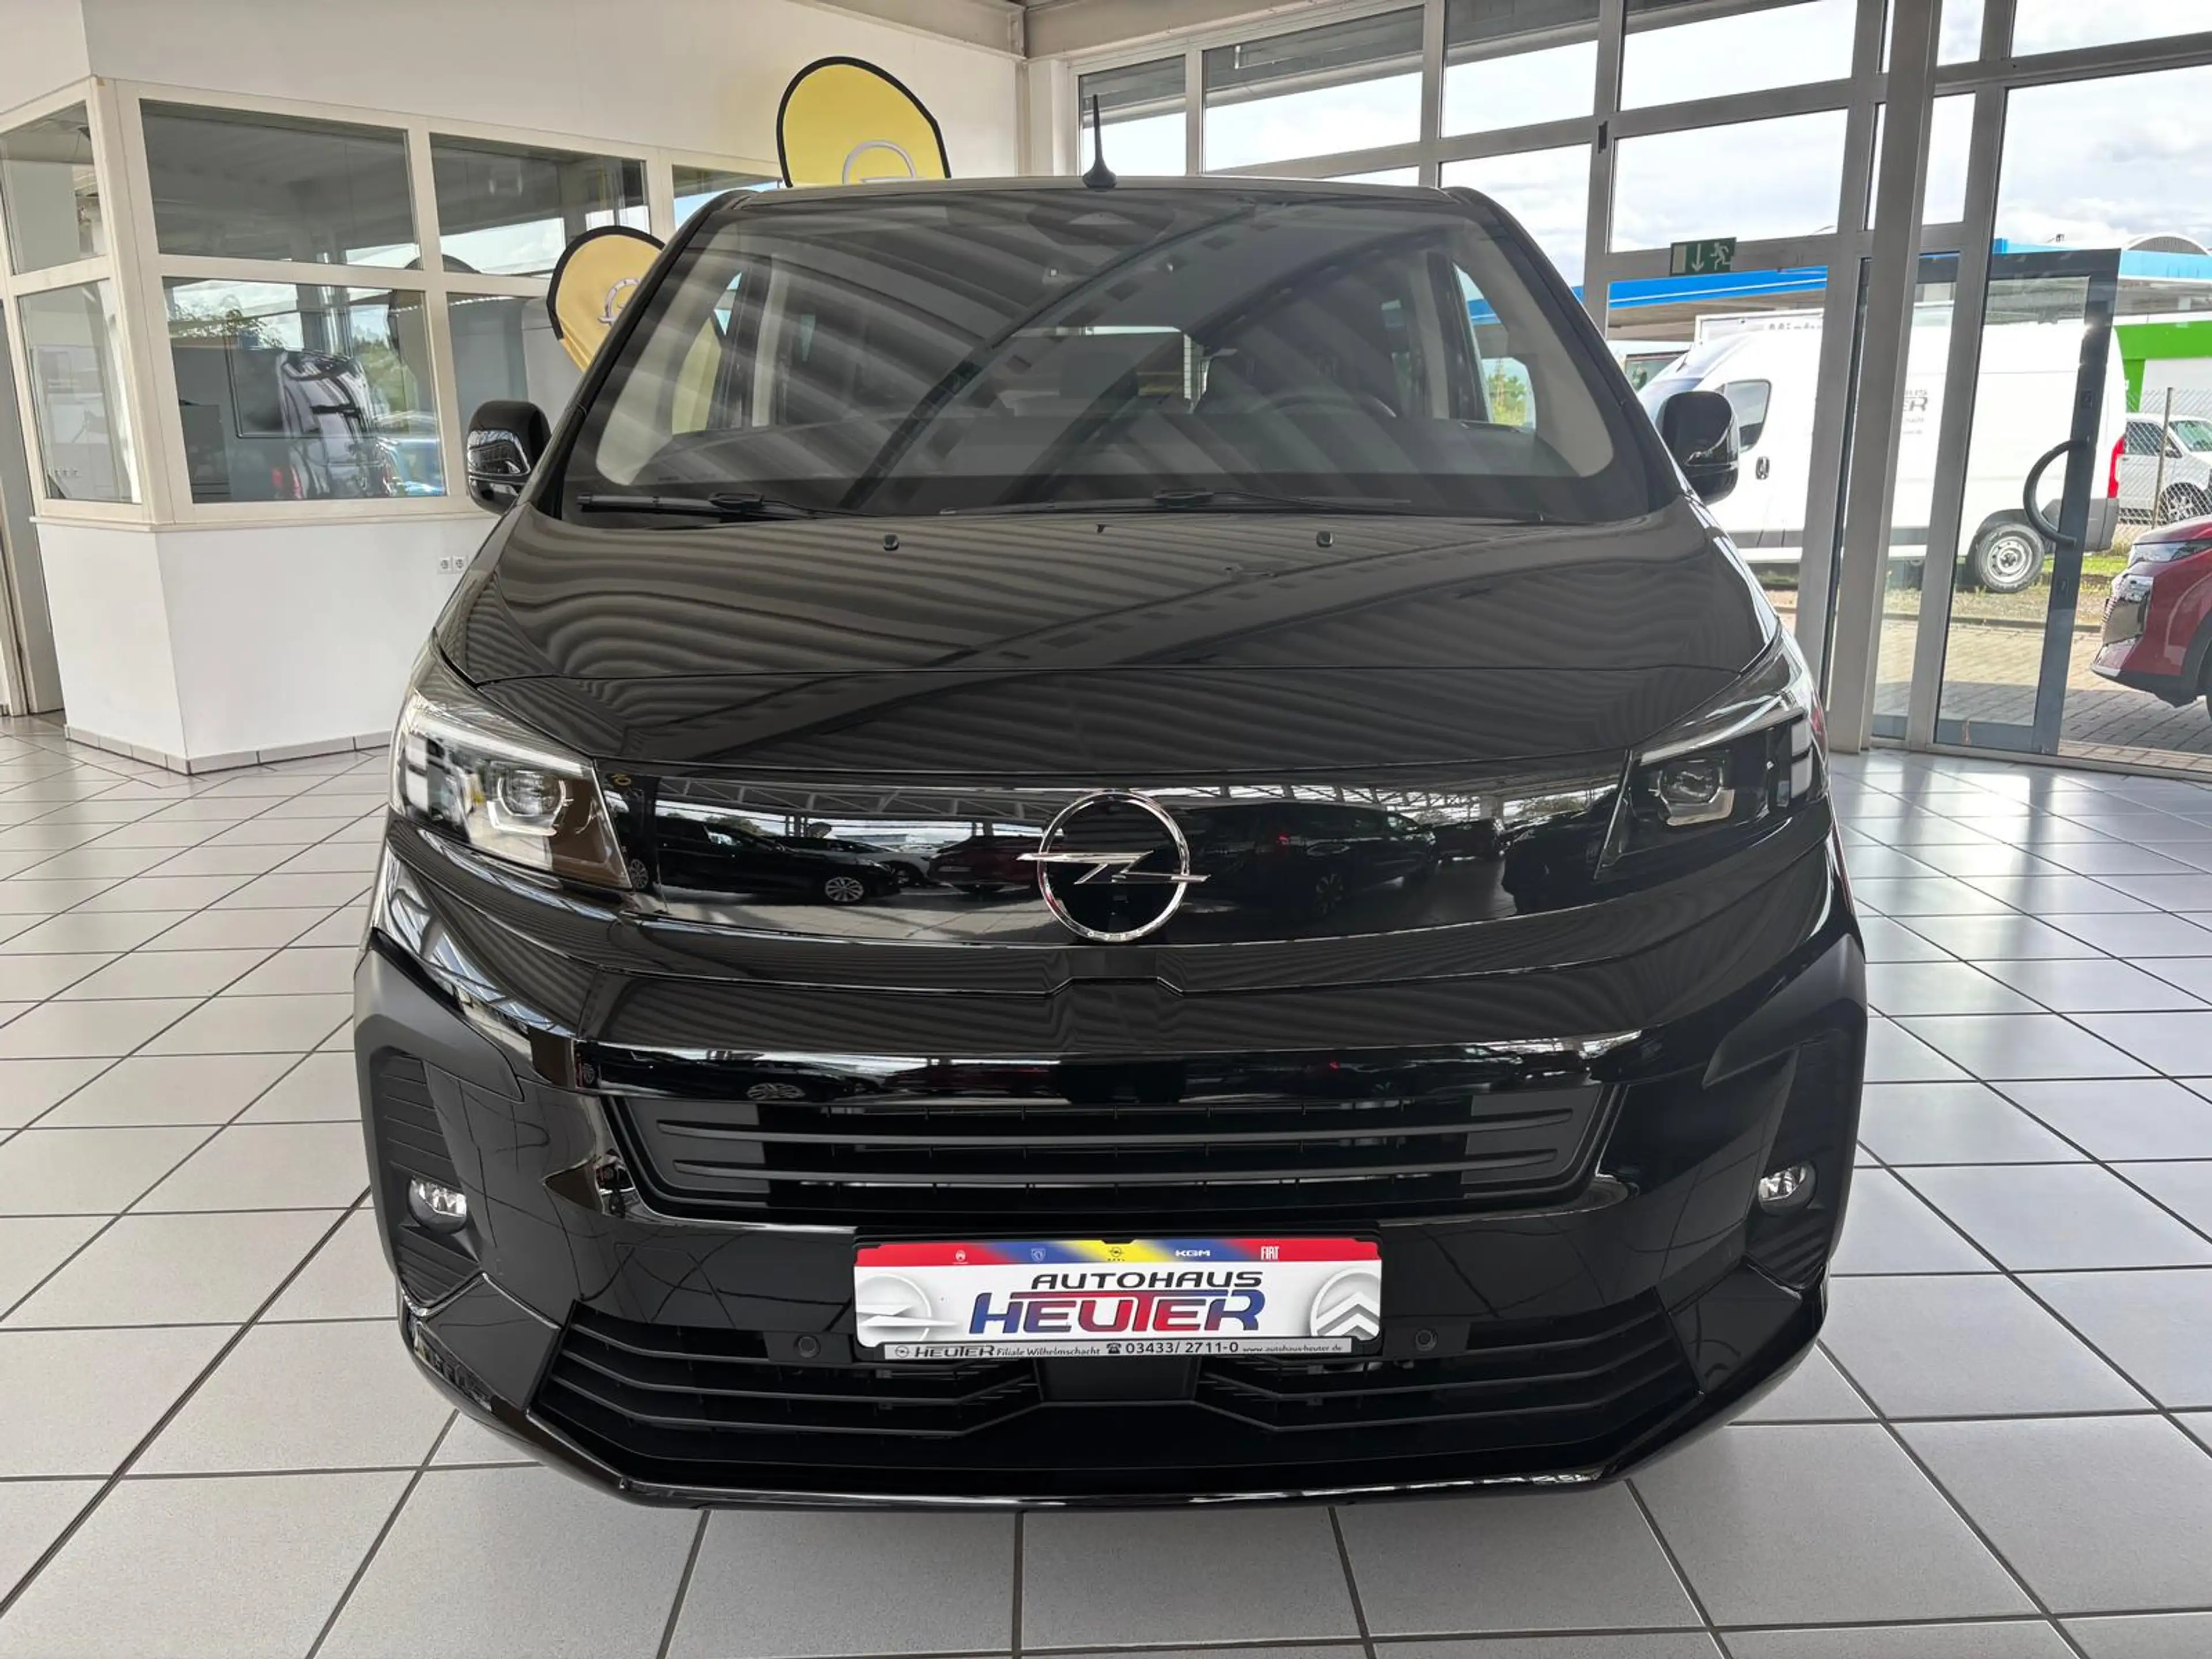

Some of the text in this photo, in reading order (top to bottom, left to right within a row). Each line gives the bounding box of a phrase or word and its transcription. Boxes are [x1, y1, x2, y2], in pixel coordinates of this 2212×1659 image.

[1261, 1245, 1280, 1260] FIAT
[1031, 1271, 1263, 1290] AUTOHAUS
[969, 1289, 1266, 1334] HEUTER
[914, 1345, 995, 1358] HEUTER
[996, 1348, 1024, 1356] Filiale
[1026, 1345, 1100, 1356] Wilhelmschacht
[1125, 1343, 1180, 1353] 03433/
[1185, 1341, 1238, 1353] 2711-0
